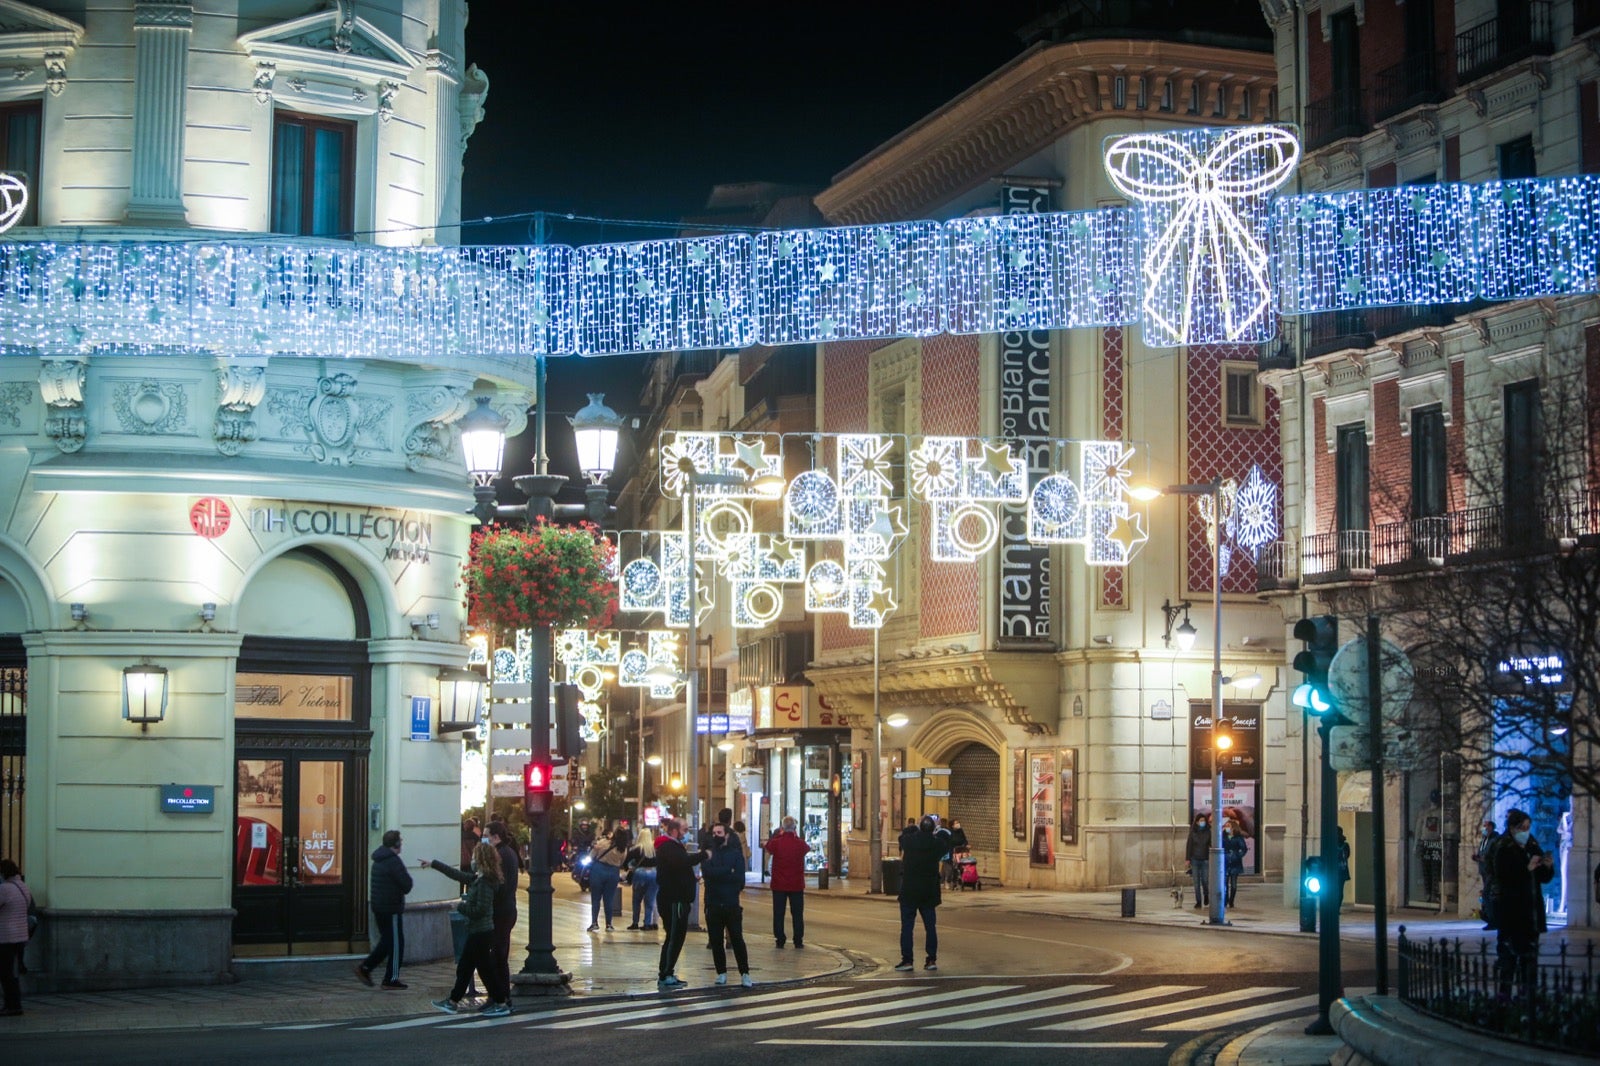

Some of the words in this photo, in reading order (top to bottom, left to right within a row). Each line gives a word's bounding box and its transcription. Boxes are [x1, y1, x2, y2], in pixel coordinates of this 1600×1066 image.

[1003, 331, 1024, 414] Blanc
[294, 509, 432, 544] COLLECTION
[246, 684, 292, 707] Hotel
[297, 686, 342, 707] Victoria
[417, 701, 426, 721] H
[177, 798, 209, 807] COLLECTION
[312, 829, 328, 838] feel
[304, 840, 335, 850] SAFE
